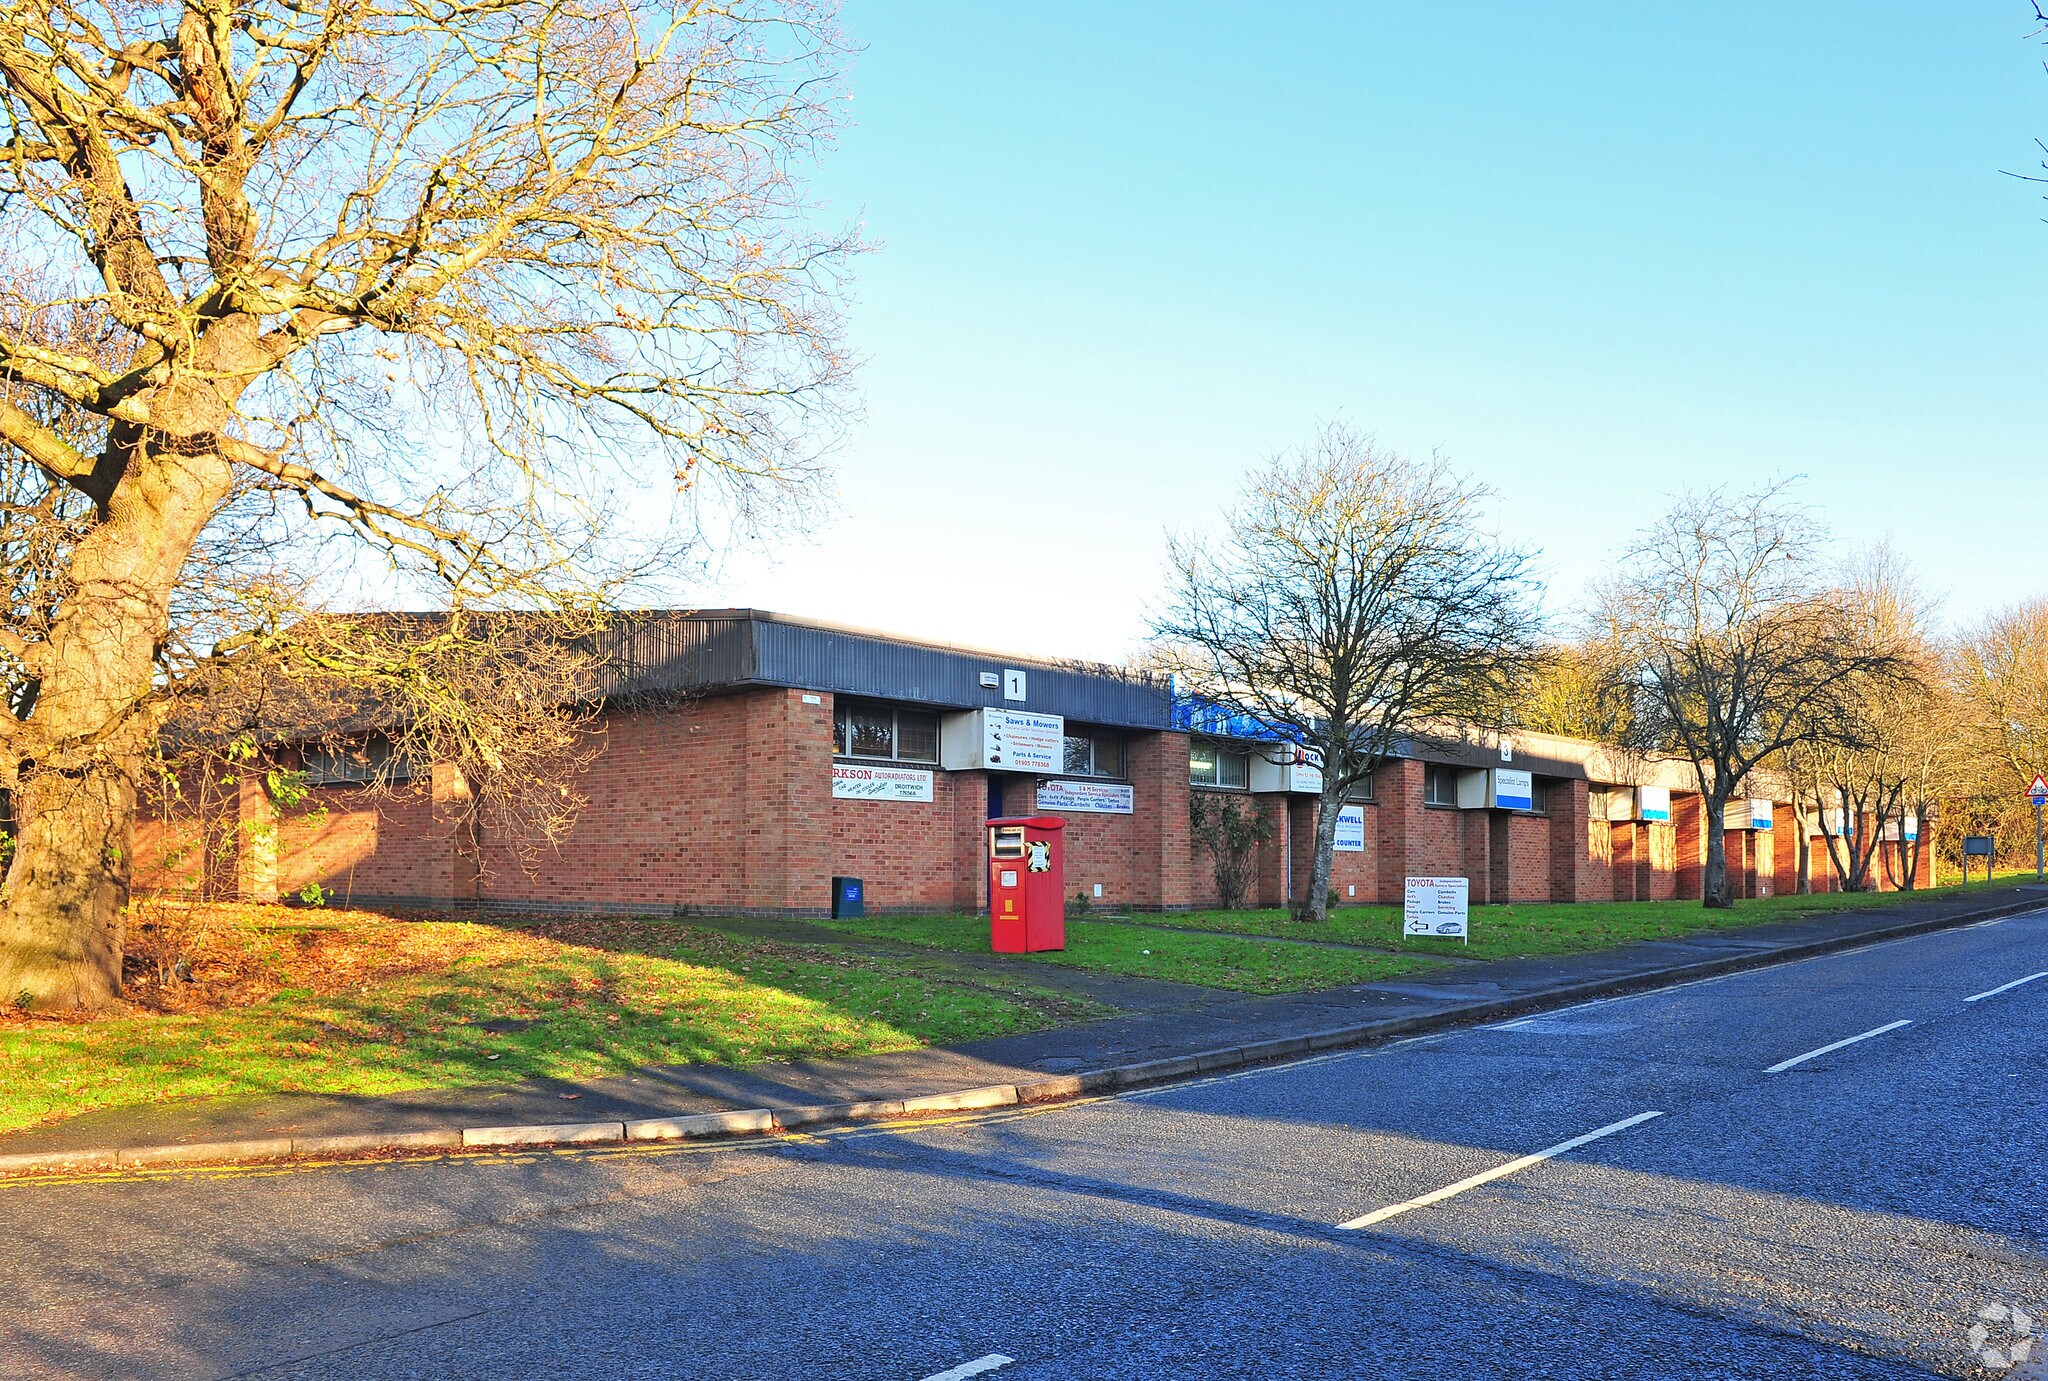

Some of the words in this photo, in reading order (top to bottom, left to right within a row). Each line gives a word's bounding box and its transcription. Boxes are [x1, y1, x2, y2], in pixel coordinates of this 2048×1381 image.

[1012, 677, 1018, 693] 1
[1005, 716, 1024, 725] Saws
[1033, 719, 1059, 730] Mowers
[874, 771, 916, 782] AUTORADIATORS
[894, 783, 923, 791] DROITWICH
[1336, 815, 1362, 824] KWELL
[1407, 879, 1434, 887] TOYOTA
